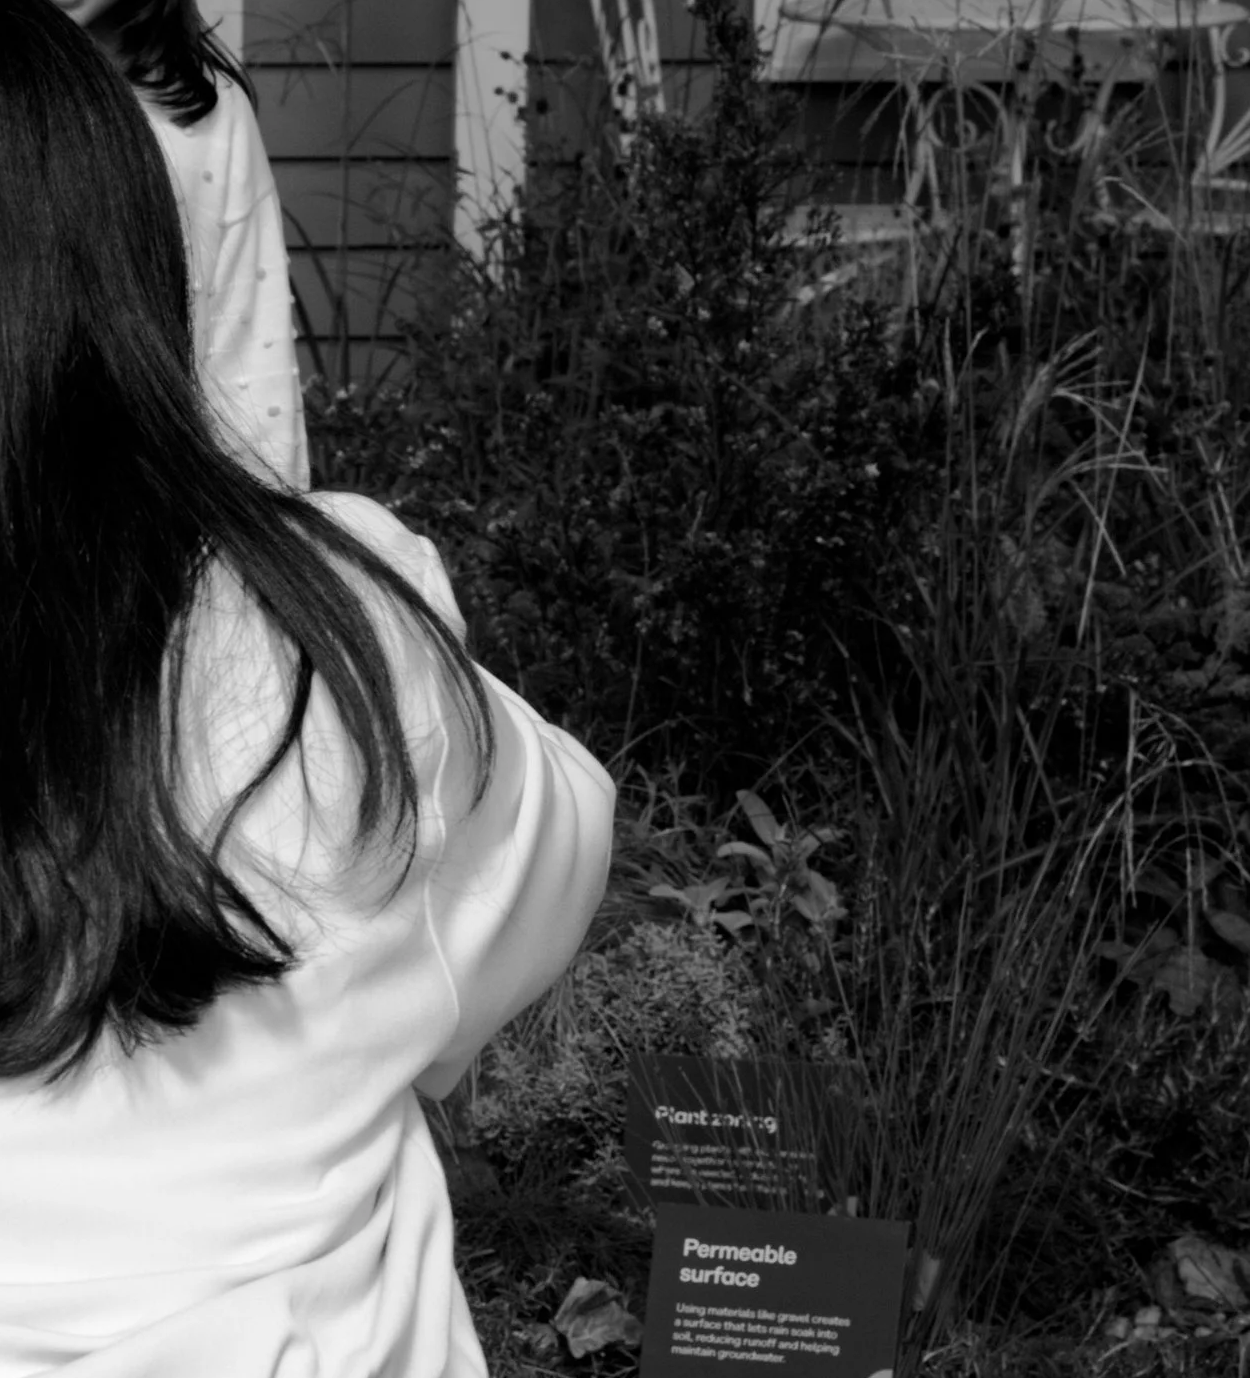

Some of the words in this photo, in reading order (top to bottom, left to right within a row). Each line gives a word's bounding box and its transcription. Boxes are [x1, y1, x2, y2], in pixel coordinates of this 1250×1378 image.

[655, 1105, 708, 1126] Plant
[711, 1113, 778, 1134] zonng
[683, 1237, 797, 1265] Permeable
[679, 1266, 760, 1288] surface
[675, 1302, 706, 1316] Using
[707, 1306, 756, 1319] materials
[757, 1309, 776, 1321] like
[777, 1312, 810, 1324] gravel
[811, 1315, 851, 1327] creates
[682, 1319, 722, 1331] surface
[724, 1321, 745, 1332] that
[747, 1323, 767, 1334] lets
[769, 1325, 789, 1336] rain
[791, 1327, 815, 1338] soak
[817, 1329, 838, 1340] into
[671, 1345, 716, 1358] maintain
[717, 1349, 786, 1363] groundwater.
[695, 1333, 741, 1348] reducing
[743, 1337, 777, 1349] runoff
[778, 1340, 799, 1351] and
[800, 1342, 840, 1356] helping
